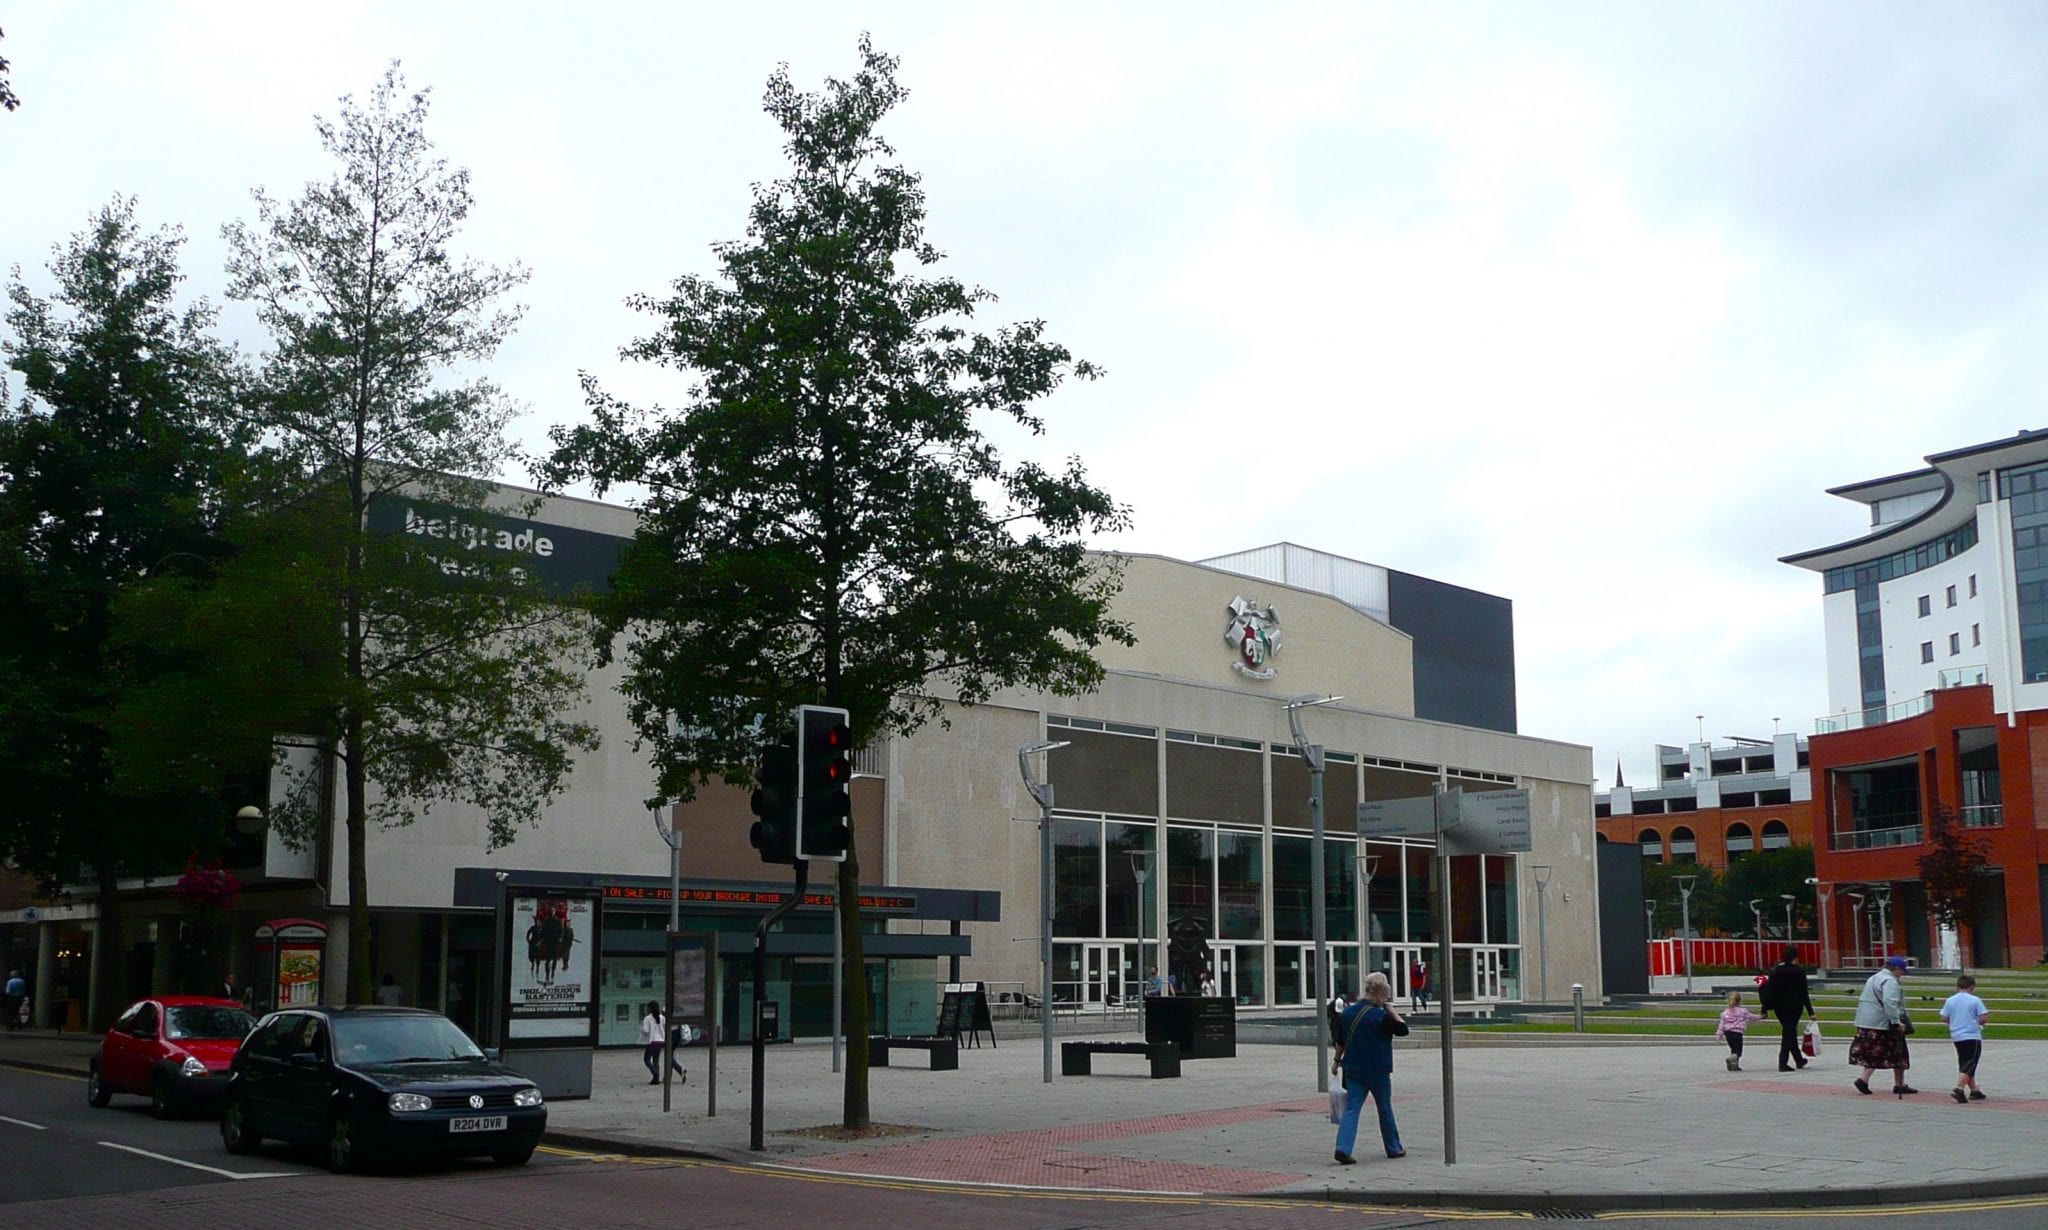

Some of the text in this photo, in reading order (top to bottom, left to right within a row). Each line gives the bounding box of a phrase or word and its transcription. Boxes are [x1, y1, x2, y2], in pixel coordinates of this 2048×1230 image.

[610, 888, 621, 897] ON
[624, 888, 645, 898] SALE
[656, 889, 673, 899] PIC
[680, 889, 691, 899] UP
[693, 890, 712, 900] YOUR
[715, 890, 751, 902] BROCHURE
[755, 893, 781, 904] INSIDE
[454, 1118, 481, 1131] R204
